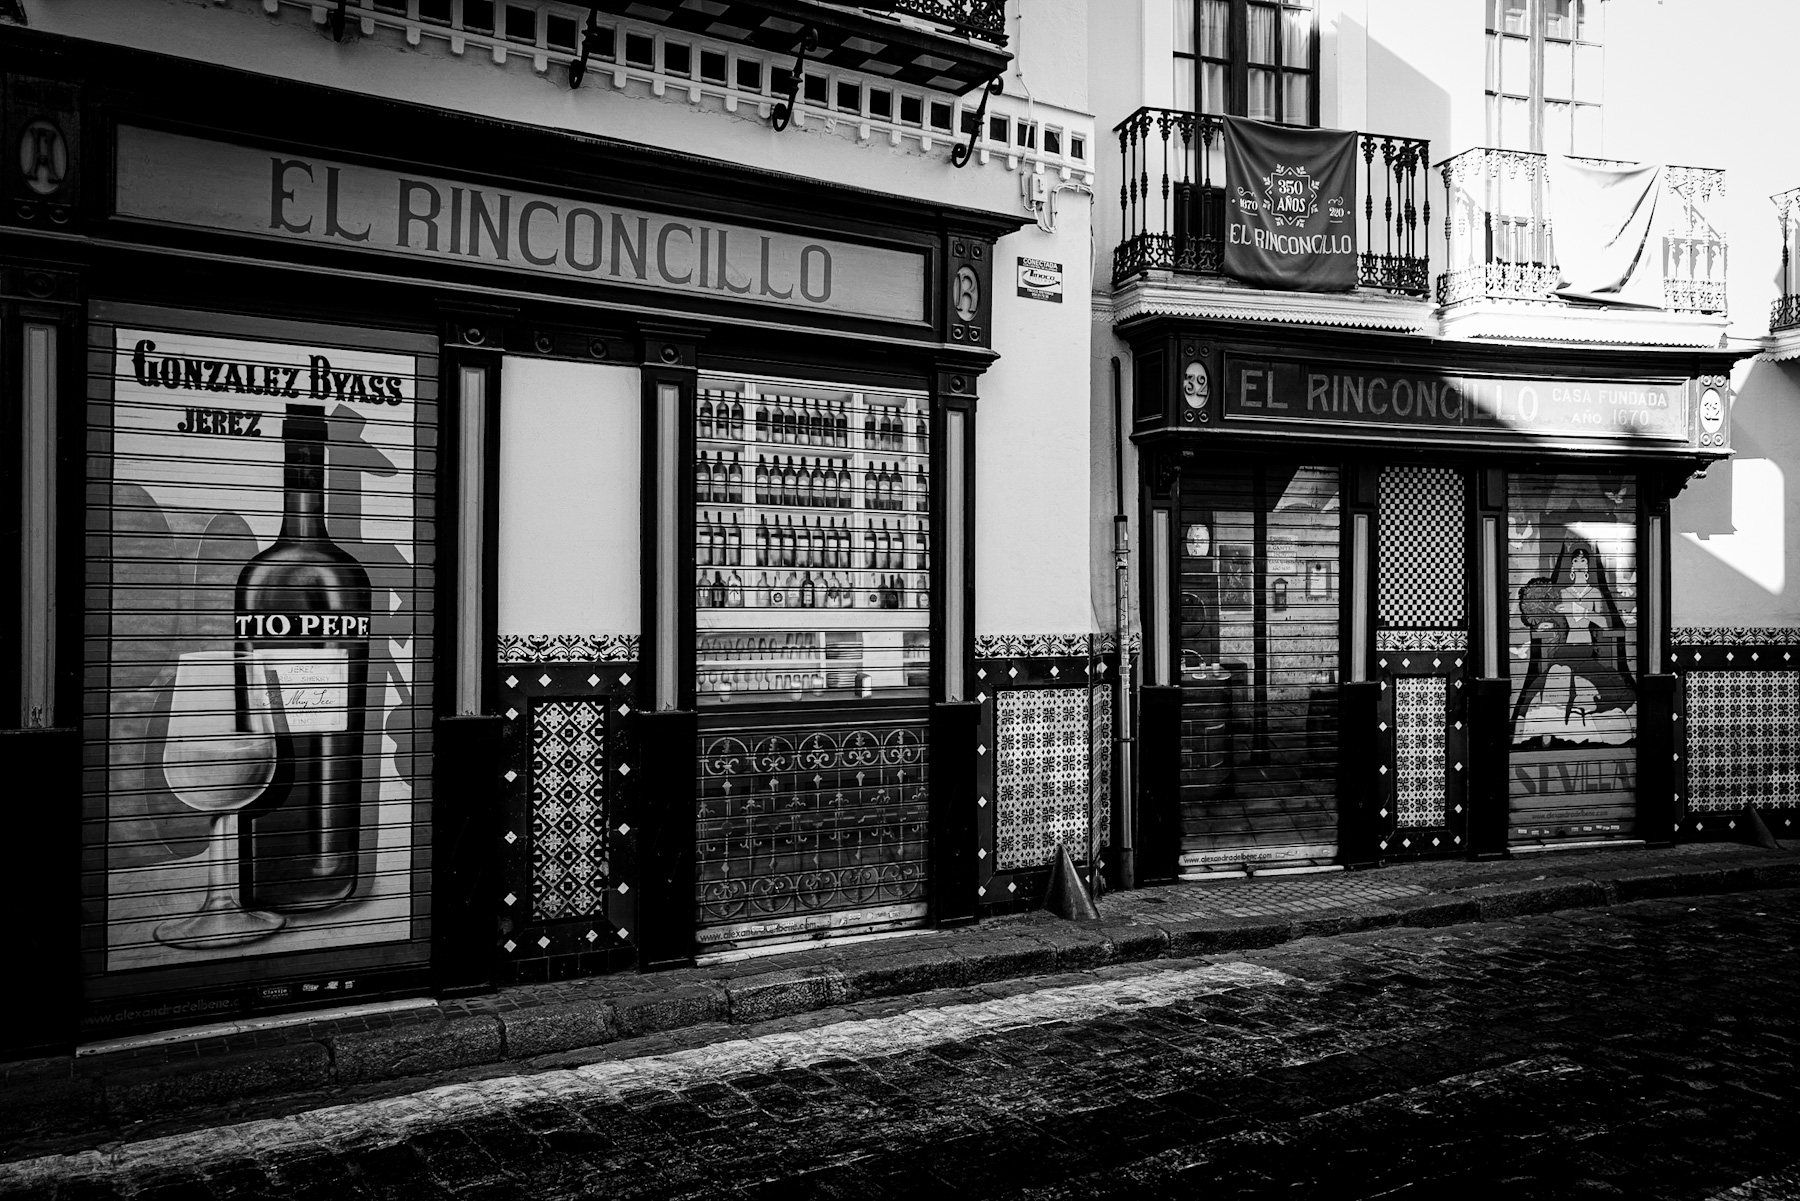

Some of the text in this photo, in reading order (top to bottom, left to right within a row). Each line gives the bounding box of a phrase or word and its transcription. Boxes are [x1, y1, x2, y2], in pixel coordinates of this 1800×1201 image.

[1276, 179, 1306, 212] 350 AÑOS
[269, 157, 833, 303] EL RINCONCILLO
[1229, 223, 1352, 255] EL RINCONCILLO
[1022, 257, 1058, 270] CONECTADA
[1184, 374, 1209, 397] 32
[1240, 368, 1539, 423] EL RINCONCILLO
[1552, 388, 1668, 408] CASA FUNDADA
[178, 406, 263, 437] JEREZ
[1571, 409, 1650, 427] AÑO 1670
[1703, 401, 1721, 422] 32
[236, 614, 371, 639] TIO PEPE
[1183, 853, 1273, 863] www.alexandradelbene.com
